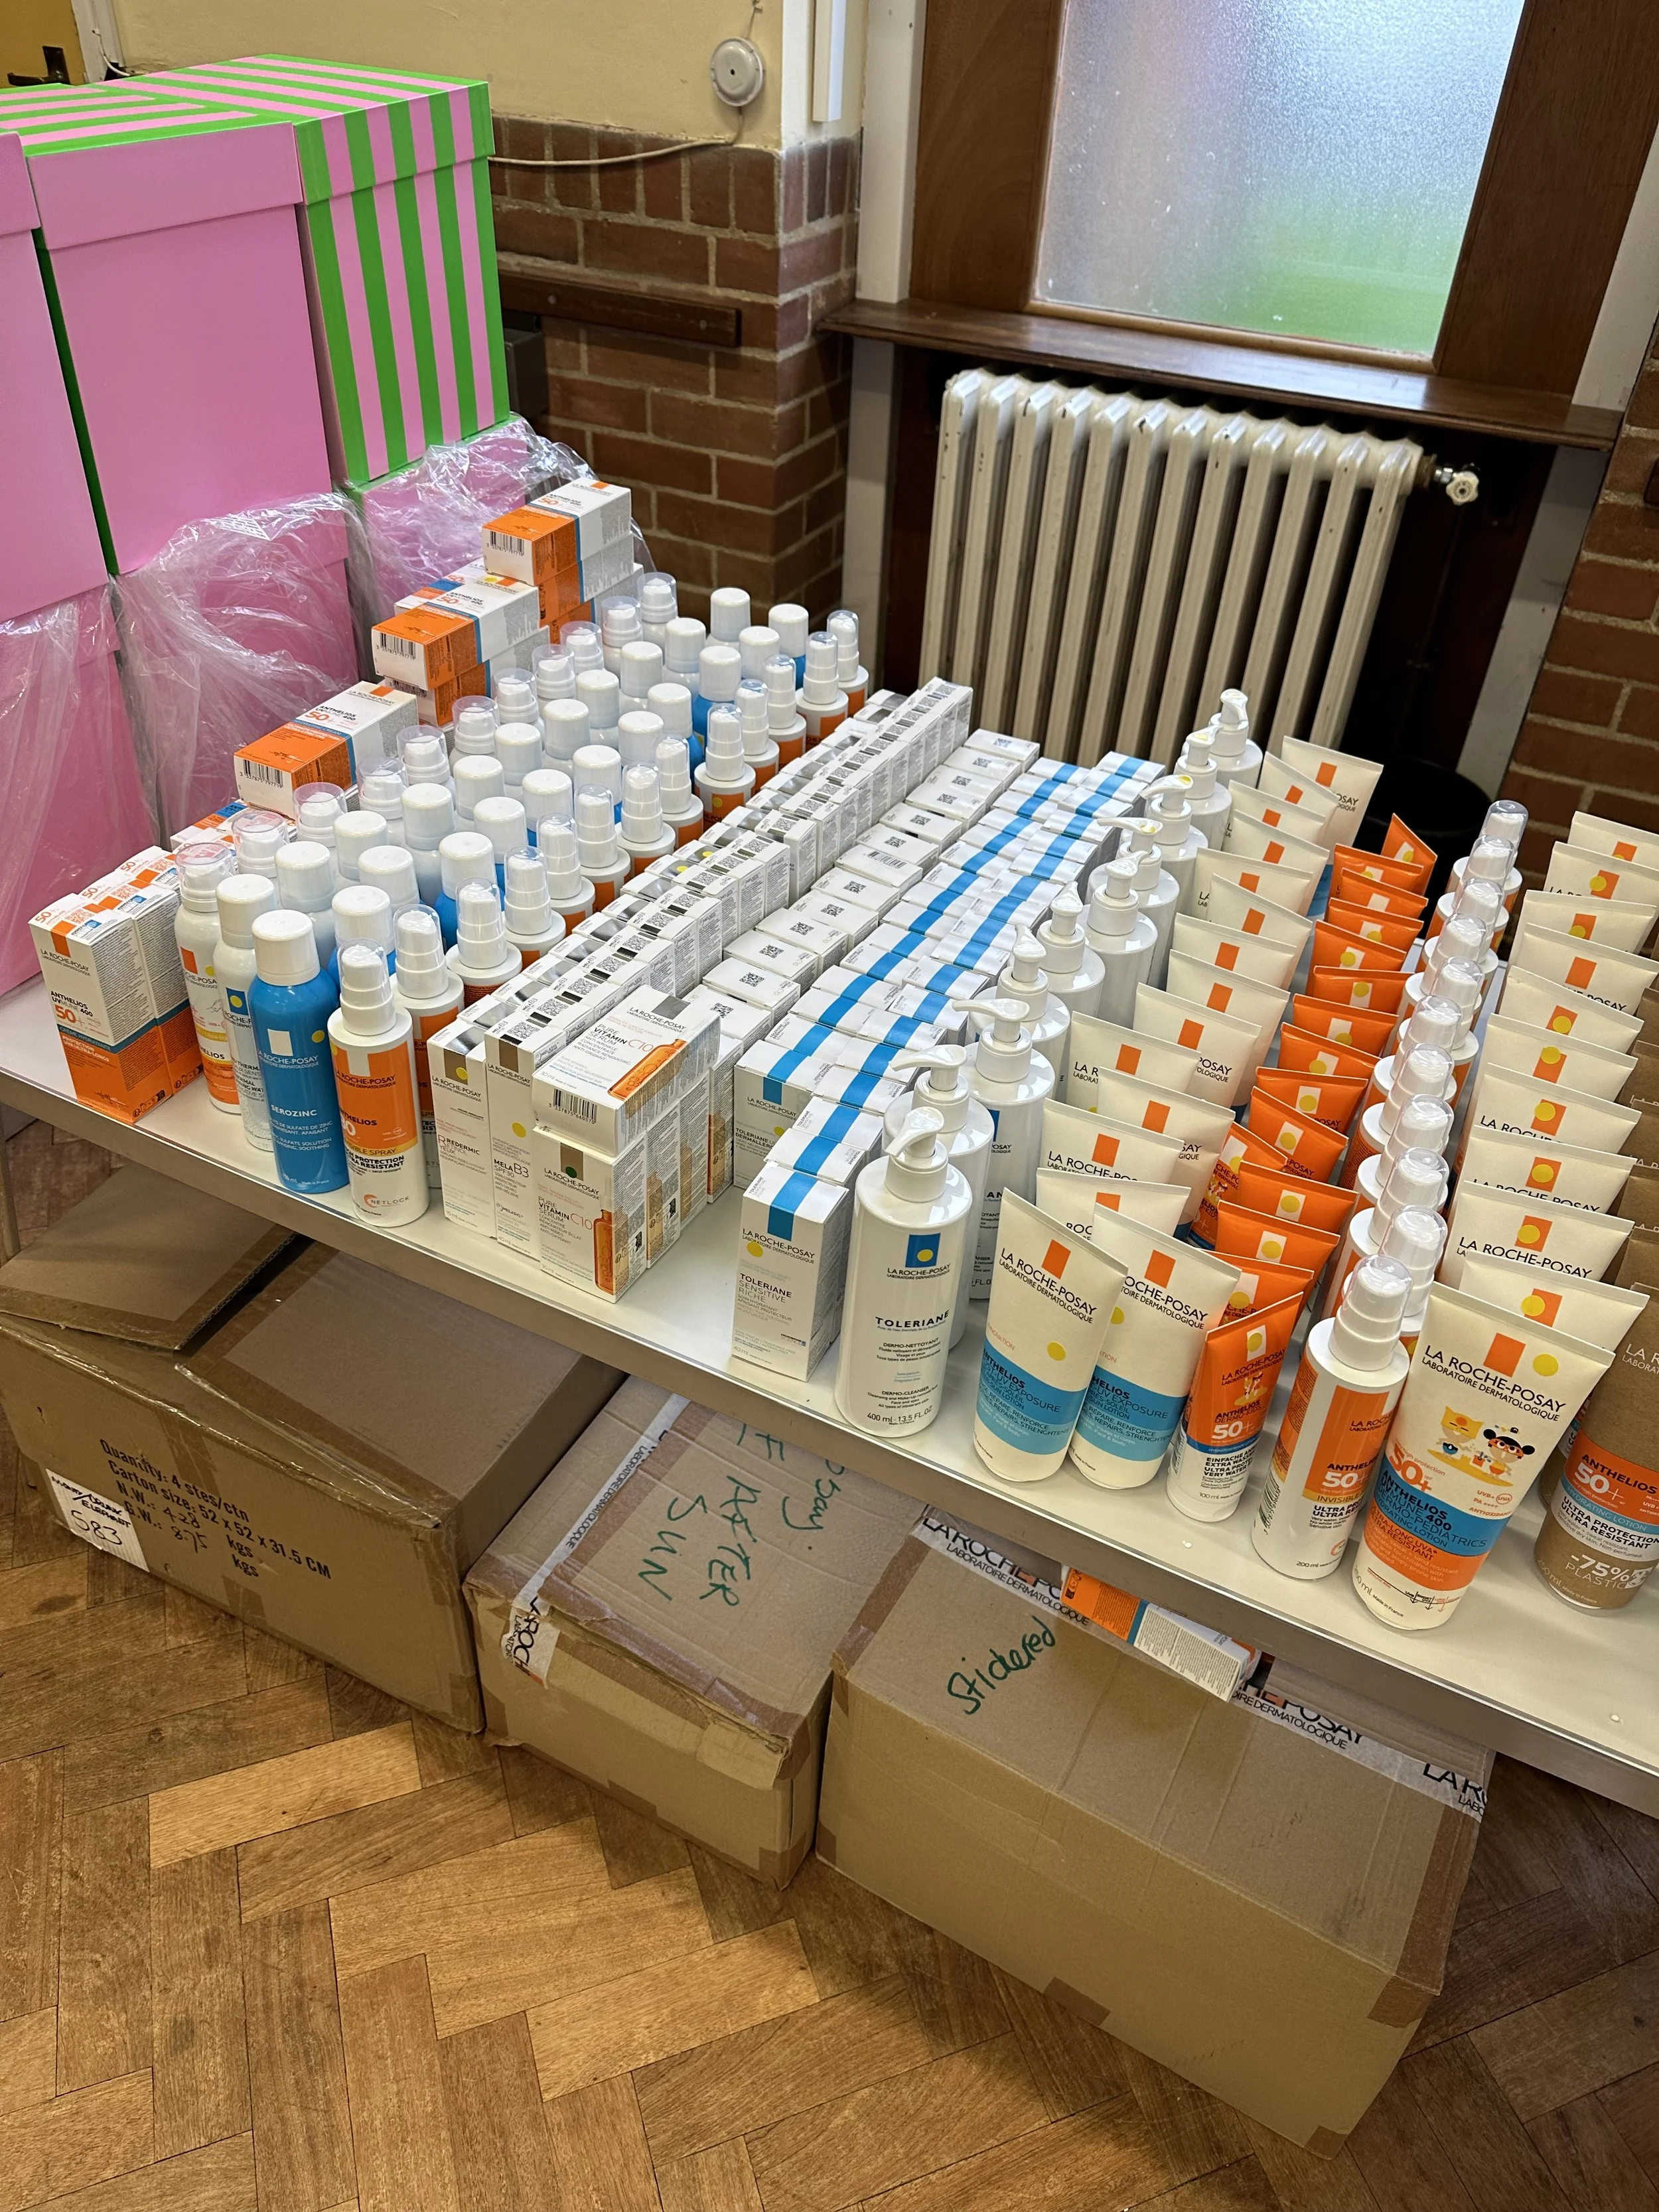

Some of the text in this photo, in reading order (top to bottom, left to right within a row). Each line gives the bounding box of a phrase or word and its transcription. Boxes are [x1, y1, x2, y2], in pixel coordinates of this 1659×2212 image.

[50, 951, 89, 971] ROCHE-POSAY
[50, 990, 88, 1009] ANTHELIOS
[80, 1008, 93, 1017] 400
[639, 1009, 687, 1030] ROCHE-POSAY
[589, 1031, 617, 1045] SERUM
[597, 1024, 620, 1035] PURE
[594, 1027, 654, 1052] VITAMIN C10
[265, 1055, 319, 1065] ROCHE-POSAY
[1074, 1061, 1088, 1072] LA
[341, 1072, 396, 1085] ROCHE-POSAY
[495, 1066, 530, 1084] ROCHE-POSAY
[440, 1079, 481, 1098] ROCHE-POSAY
[271, 1104, 318, 1117] SEROZINC
[756, 1099, 797, 1117] ROCHE-POSAY
[1480, 1115, 1496, 1130] LA
[735, 1128, 768, 1142] TOLERIANE
[447, 1138, 480, 1155] REDERMIC
[354, 1155, 405, 1164] PROTECTION
[360, 1161, 404, 1169] RESISTANT
[1048, 1151, 1062, 1163] LA
[494, 1159, 530, 1178] MELA B3
[494, 1165, 515, 1178] SPF30
[544, 1167, 599, 1195] LA ROCHE-POSAY
[371, 1196, 409, 1205] NETLOCK
[539, 1196, 557, 1208] PURE
[538, 1202, 593, 1230] VITAMIN C10
[743, 1228, 815, 1259] LA ROCHE-POSAY
[772, 1248, 815, 1264] DERMATOLOGIQUE
[1459, 1236, 1593, 1279] LA ROCHE-POSAY
[899, 1264, 951, 1276] ROCHE-POSAY
[740, 1273, 792, 1298] TOLERIANE
[1001, 1248, 1013, 1263] LA
[1016, 1258, 1098, 1315] ROCHE-POSAY
[738, 1287, 766, 1302] RICHE
[739, 1280, 786, 1303] SENSITIVE
[998, 1258, 1037, 1289] LABORATOIRE
[1035, 1283, 1094, 1325] DERMATOLOGIQUE
[875, 1309, 950, 1328] TOLERIANE
[1140, 1295, 1205, 1330] DERMATOLOGIQUE
[883, 1337, 940, 1349] DERMO-NETTOYANT
[1626, 1343, 1646, 1361] LA
[1221, 1349, 1286, 1381] LA ROCHE-POSAY
[1425, 1345, 1567, 1413] LA ROCHE-POSAY
[881, 1386, 929, 1396] DERMO-CLEANSER
[1009, 1382, 1062, 1413] EXPOSURE
[1422, 1357, 1560, 1422] LABORATOIRE DERMATOLOGIQUE
[1110, 1394, 1169, 1420] EXPOSURE
[1214, 1405, 1262, 1424] DERMO-KIDS
[1216, 1399, 1262, 1419] ANTHELIOS
[867, 1412, 881, 1422] 400
[1012, 1409, 1050, 1430] RENFORCE
[1116, 1420, 1156, 1438] RENFORCE
[1206, 1452, 1244, 1463] EINFACHE
[1414, 1455, 1446, 1476] protection
[1226, 1465, 1248, 1476] WATER
[1581, 1454, 1658, 1495] ANTHELIOS
[172, 1475, 180, 1489] 4
[115, 1479, 156, 1510] N.W.:
[565, 1444, 650, 1549] LABORATOIRE DERMATOLOGIQUE
[1317, 1492, 1364, 1503] INVISIBLE
[1382, 1469, 1449, 1520] ANTHELIOS
[123, 1500, 163, 1530] G.W.:
[1313, 1510, 1344, 1518] ULTRA
[1314, 1505, 1346, 1513] ULTRA
[1567, 1486, 1647, 1532] HYDRATING LOTION
[108, 1460, 159, 1494] Carton
[161, 1489, 196, 1513] size:
[199, 1505, 220, 1524] 52
[222, 1518, 232, 1530] x
[234, 1521, 255, 1542] 52
[271, 1538, 303, 1565] 31.5
[306, 1556, 332, 1580] CM
[1426, 1513, 1453, 1532] 400
[1561, 1503, 1651, 1550] ULTRA RESISTANT
[1563, 1496, 1659, 1544] ULTRA PROTECTION
[226, 1534, 253, 1558] kgs
[1387, 1530, 1433, 1561] RESISTANT
[1413, 1526, 1448, 1548] LOTION
[232, 1554, 259, 1577] kgs
[1571, 1554, 1630, 1582] -75%
[946, 1542, 1090, 1626] LABORATOIRE DERMATOLOGIQUE
[1565, 1562, 1628, 1590] PLASTIC
[1253, 1695, 1348, 1750] DERMATOLOGIQUE
